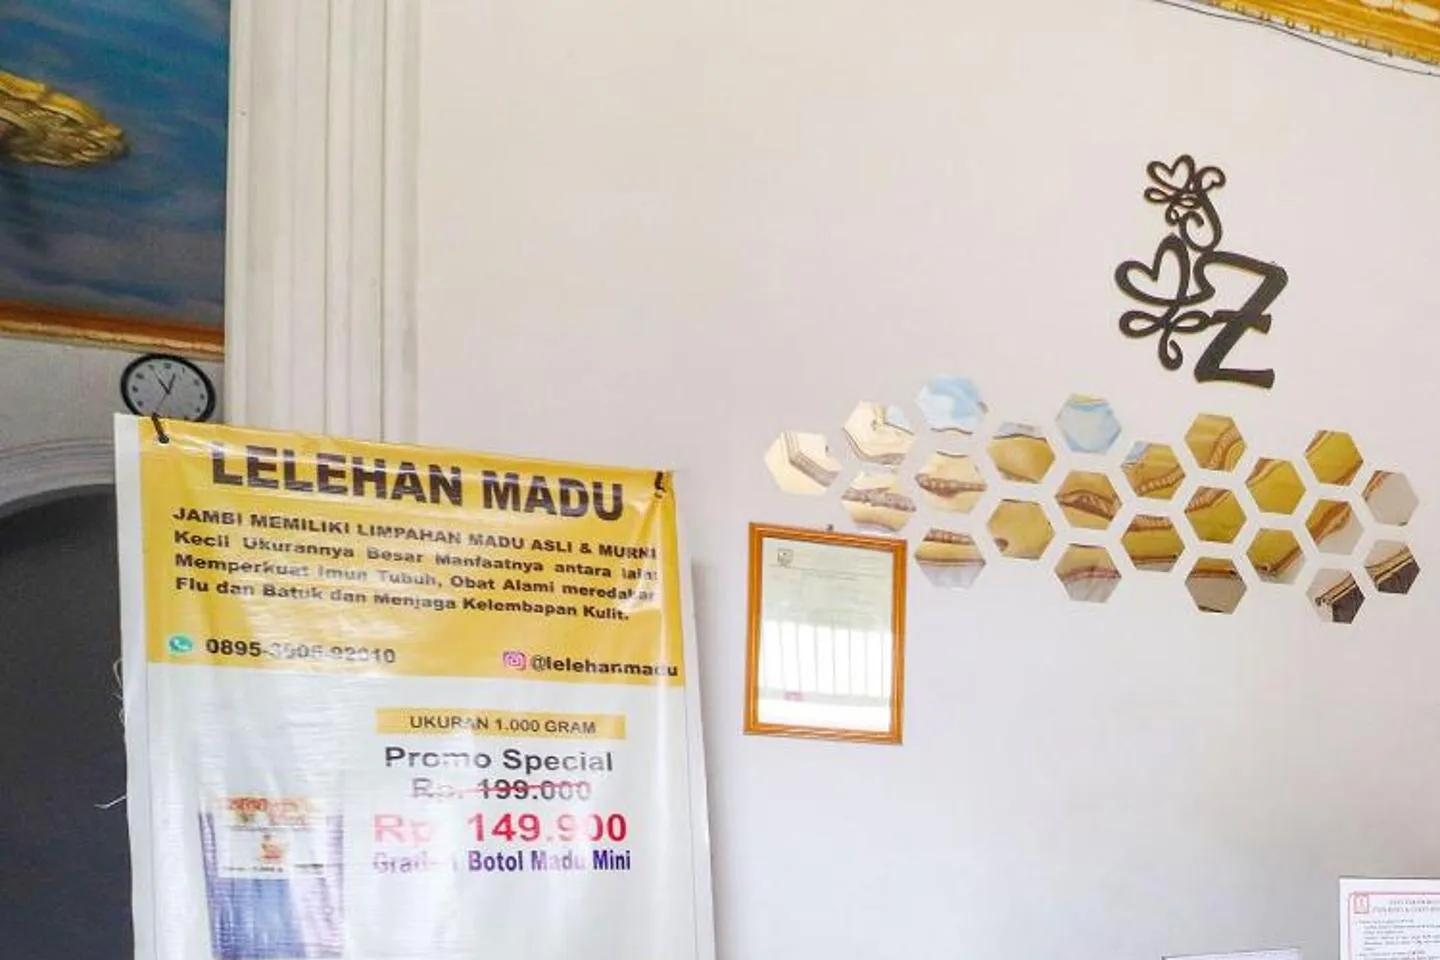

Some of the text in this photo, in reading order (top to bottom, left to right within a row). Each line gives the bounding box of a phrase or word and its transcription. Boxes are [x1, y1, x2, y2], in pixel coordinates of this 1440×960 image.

[211, 443, 624, 521] LELEHAN MADU
[172, 507, 657, 560] JAMBI MEMILIKI LIMPAHAN MADU ASLI & MURNI
[174, 530, 230, 548] Kecil
[243, 536, 354, 559] Ukurannya
[366, 546, 422, 563] Besar
[435, 555, 544, 573] Manfaatnya
[554, 563, 612, 578] antara
[175, 553, 311, 577] Memperkuat
[317, 564, 368, 581] Imun
[376, 569, 443, 588] Tubuh,
[450, 575, 495, 590] Obat
[503, 580, 554, 594] Alami
[175, 577, 629, 620] Flu dan Batuk dan Menjaga Kelembapan Kulit.
[409, 715, 597, 734] UKURAN 1.000 GRAM
[384, 747, 613, 774] Promo Special
[477, 777, 591, 801] 199.000
[468, 850, 523, 872] Botol
[593, 849, 631, 871] Mini
